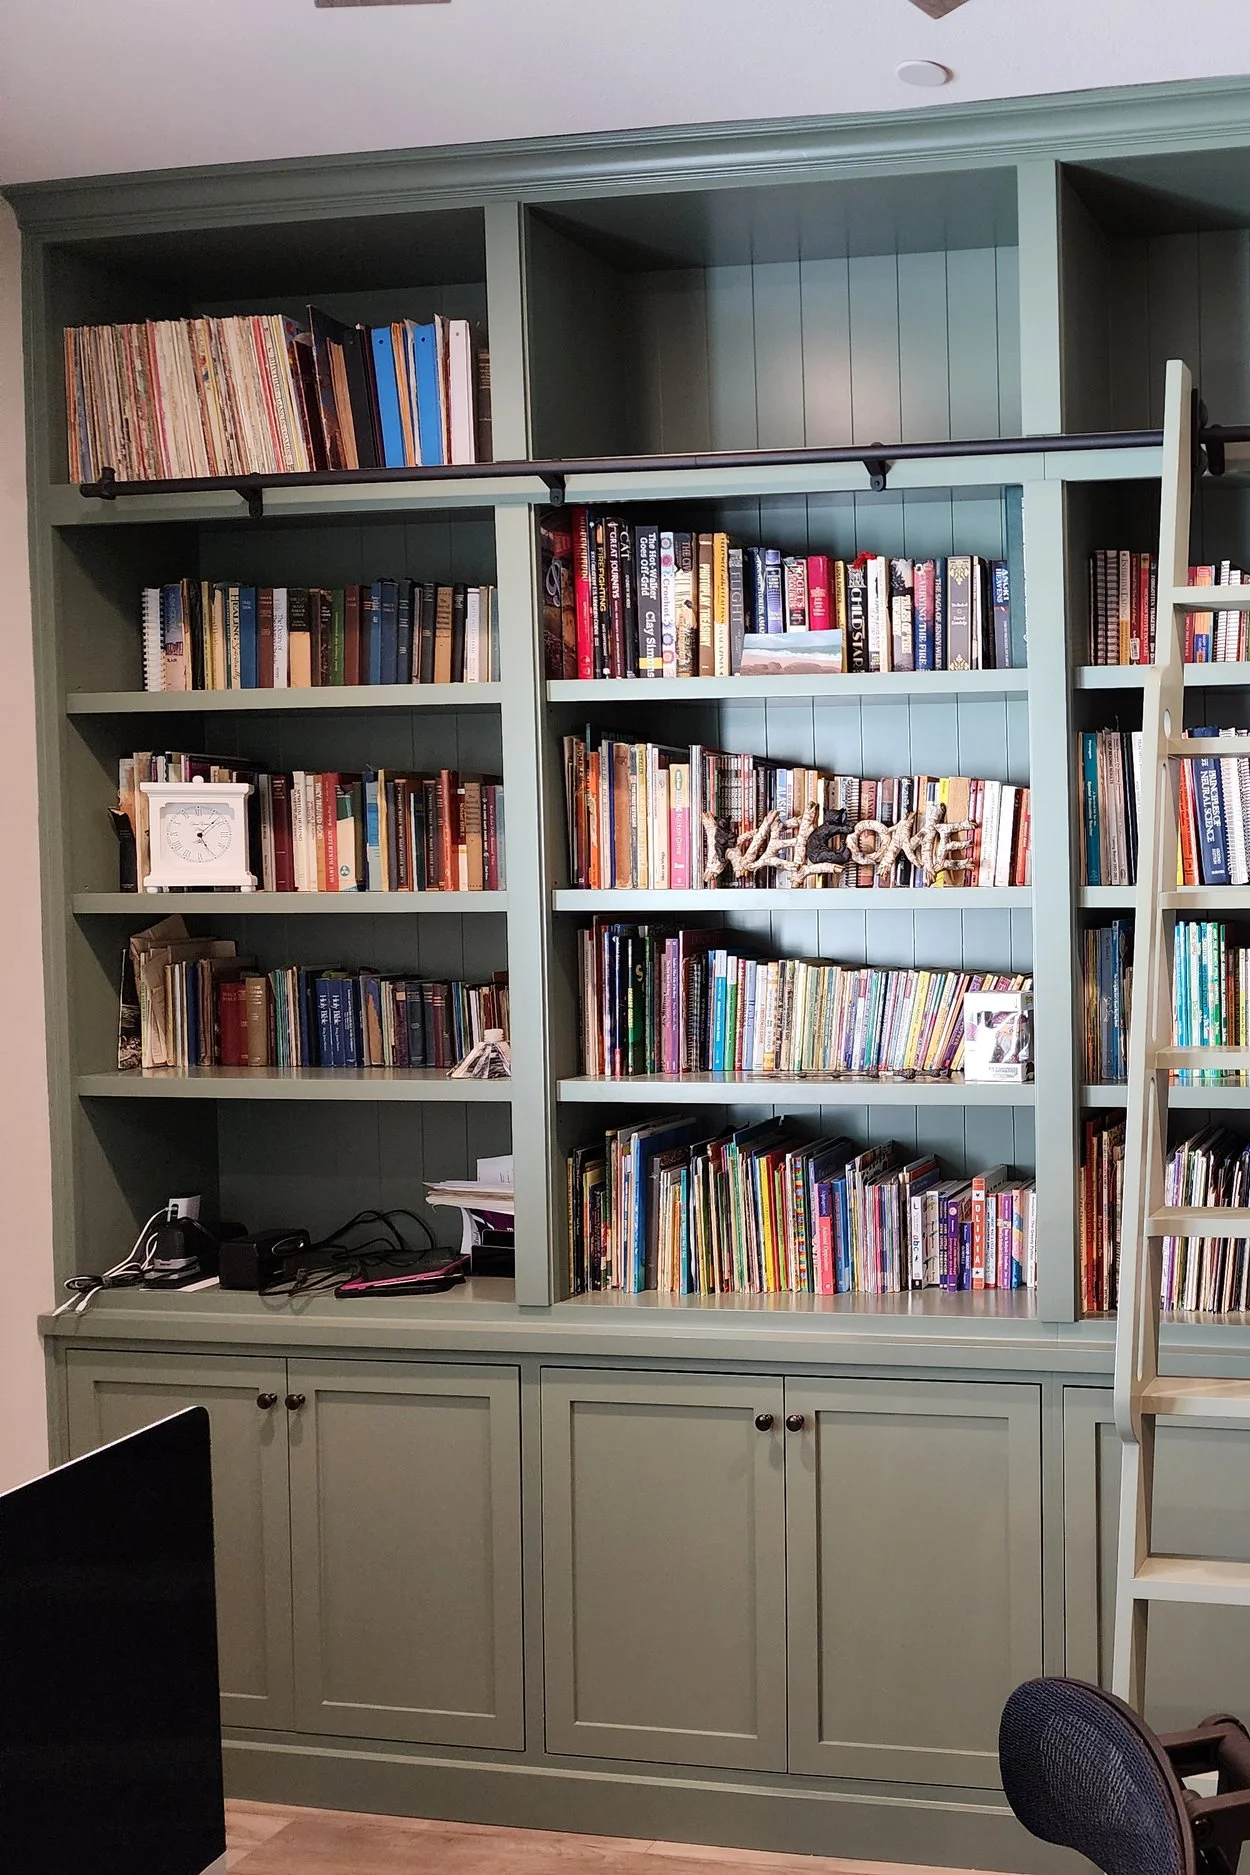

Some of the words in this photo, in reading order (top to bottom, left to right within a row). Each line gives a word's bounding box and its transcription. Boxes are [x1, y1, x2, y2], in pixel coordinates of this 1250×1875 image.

[620, 531, 630, 560] CAT
[648, 532, 656, 549] The
[682, 542, 690, 556] THE
[597, 548, 606, 612] FIREFIGHTING
[610, 560, 619, 598] JOURNEYS
[641, 560, 650, 596] Off-Grid
[650, 550, 658, 600] Hot-Walker
[700, 564, 711, 606] PHOTOPLAY
[796, 564, 804, 608] ROGET'S
[996, 568, 1004, 603] HEAVENS
[662, 578, 670, 617] Crochet
[732, 572, 742, 623] FLIGHT
[850, 588, 862, 628] CHILD
[902, 595, 912, 621] TALES
[918, 574, 926, 621] CARRYING
[231, 594, 240, 640] HEALING
[644, 612, 655, 636] Clay
[700, 608, 710, 647] TREASURY
[902, 622, 912, 635] OF
[918, 623, 926, 642] THE
[935, 612, 941, 622] OF
[646, 637, 656, 677] Simons
[852, 632, 864, 667] STAR
[919, 644, 927, 665] FIRE
[778, 786, 786, 817] ALASKA
[1200, 771, 1210, 808] NEURAL
[1208, 770, 1220, 816] PRINCIPLES
[1214, 816, 1221, 826] OF
[1204, 808, 1214, 842] SCIENCE
[701, 800, 977, 888] WELCOME
[318, 994, 328, 1010] Holy
[320, 1010, 328, 1024] Bible
[332, 994, 341, 1010] Holy
[333, 1010, 341, 1024] Bible
